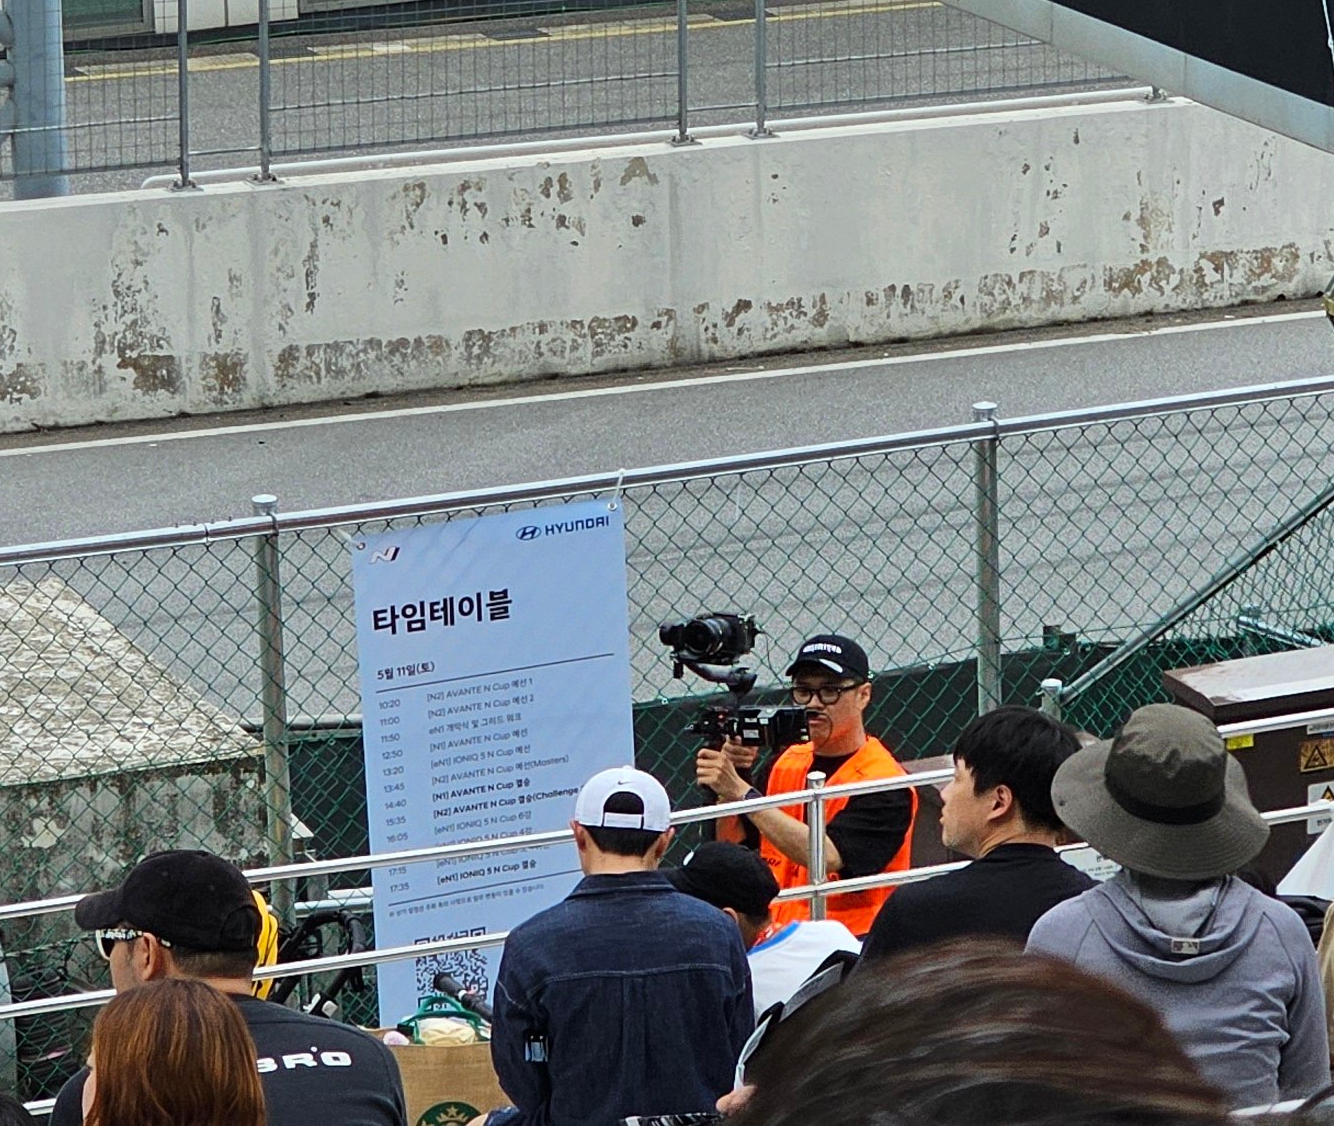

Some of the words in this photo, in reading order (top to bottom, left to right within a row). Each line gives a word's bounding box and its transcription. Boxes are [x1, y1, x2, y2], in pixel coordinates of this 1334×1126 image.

[545, 515, 609, 536] HYUNDAI
[373, 588, 512, 635] 타임테이블
[377, 667, 394, 680] 5월
[397, 661, 435, 677] 11일(토)
[447, 685, 481, 699] AVANTE
[492, 681, 510, 692] Cup
[379, 699, 401, 710] 10:20
[447, 702, 482, 715] AVANTE
[493, 699, 511, 709] Cup
[380, 716, 400, 726] 11:00
[447, 735, 482, 749] AVANTE
[493, 732, 511, 742] Cup
[496, 749, 514, 758] Cup
[450, 768, 486, 782] AVANTE
[496, 765, 514, 775] Cup
[450, 785, 486, 798] AVANTE
[496, 782, 514, 791] Cup
[453, 801, 488, 814] AVANTE
[498, 798, 516, 808] Cup
[502, 864, 519, 874] Cup
